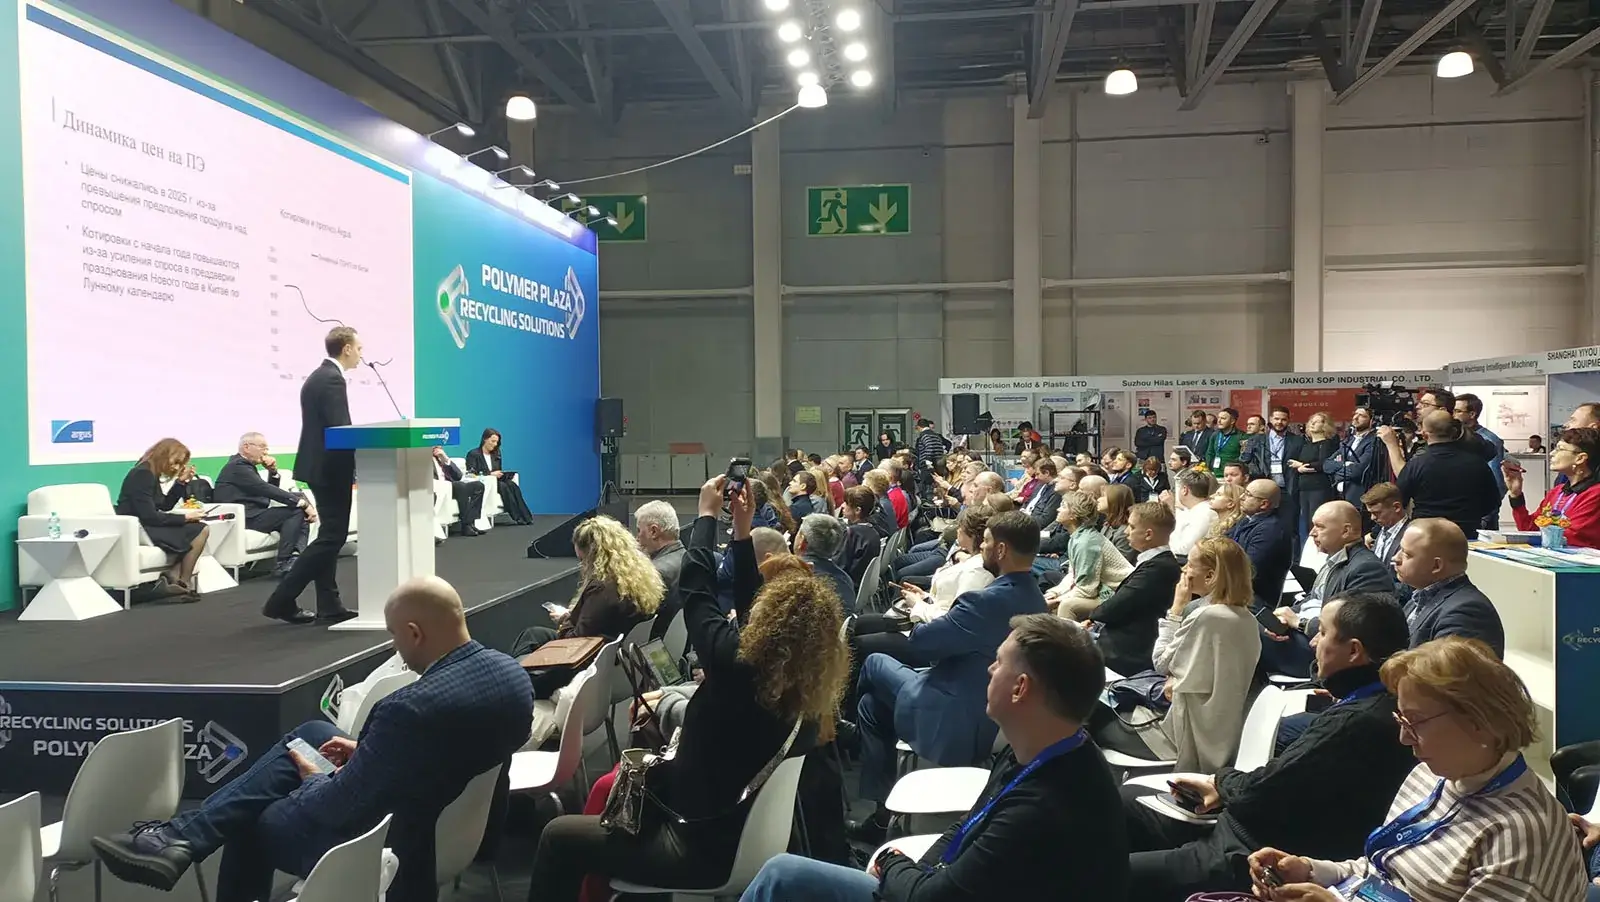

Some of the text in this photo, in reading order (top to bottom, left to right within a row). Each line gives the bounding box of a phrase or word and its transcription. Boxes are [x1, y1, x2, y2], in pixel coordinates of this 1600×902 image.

[62, 109, 206, 172] Динамика цен на ПЭ
[80, 162, 108, 180] Цены
[110, 173, 159, 195] снижались
[167, 188, 187, 203] 2025
[81, 199, 122, 217] спросом
[81, 225, 132, 246] Котировки
[133, 240, 139, 248] с
[140, 242, 171, 256] начала
[173, 247, 191, 260] года
[82, 245, 108, 259] из-за
[109, 250, 152, 267] усиления
[154, 259, 183, 273] спроса
[82, 262, 148, 282] празднования
[150, 272, 180, 288] Нового
[83, 277, 125, 297] Лунному
[481, 263, 572, 313] POLYMER PLAZA
[460, 298, 565, 339] RECYCLING SOLUTIONS
[1511, 359, 1538, 369] Machinery
[1547, 350, 1577, 361] SHANGHAI
[1013, 381, 1032, 389] Mold
[1071, 380, 1087, 388] LTD
[1210, 378, 1245, 387] Systems
[1279, 377, 1314, 385] JIANGXI
[71, 431, 93, 440] argus
[1, 716, 194, 733] RECYCLING SOLUTIS
[33, 740, 96, 756] POLY
